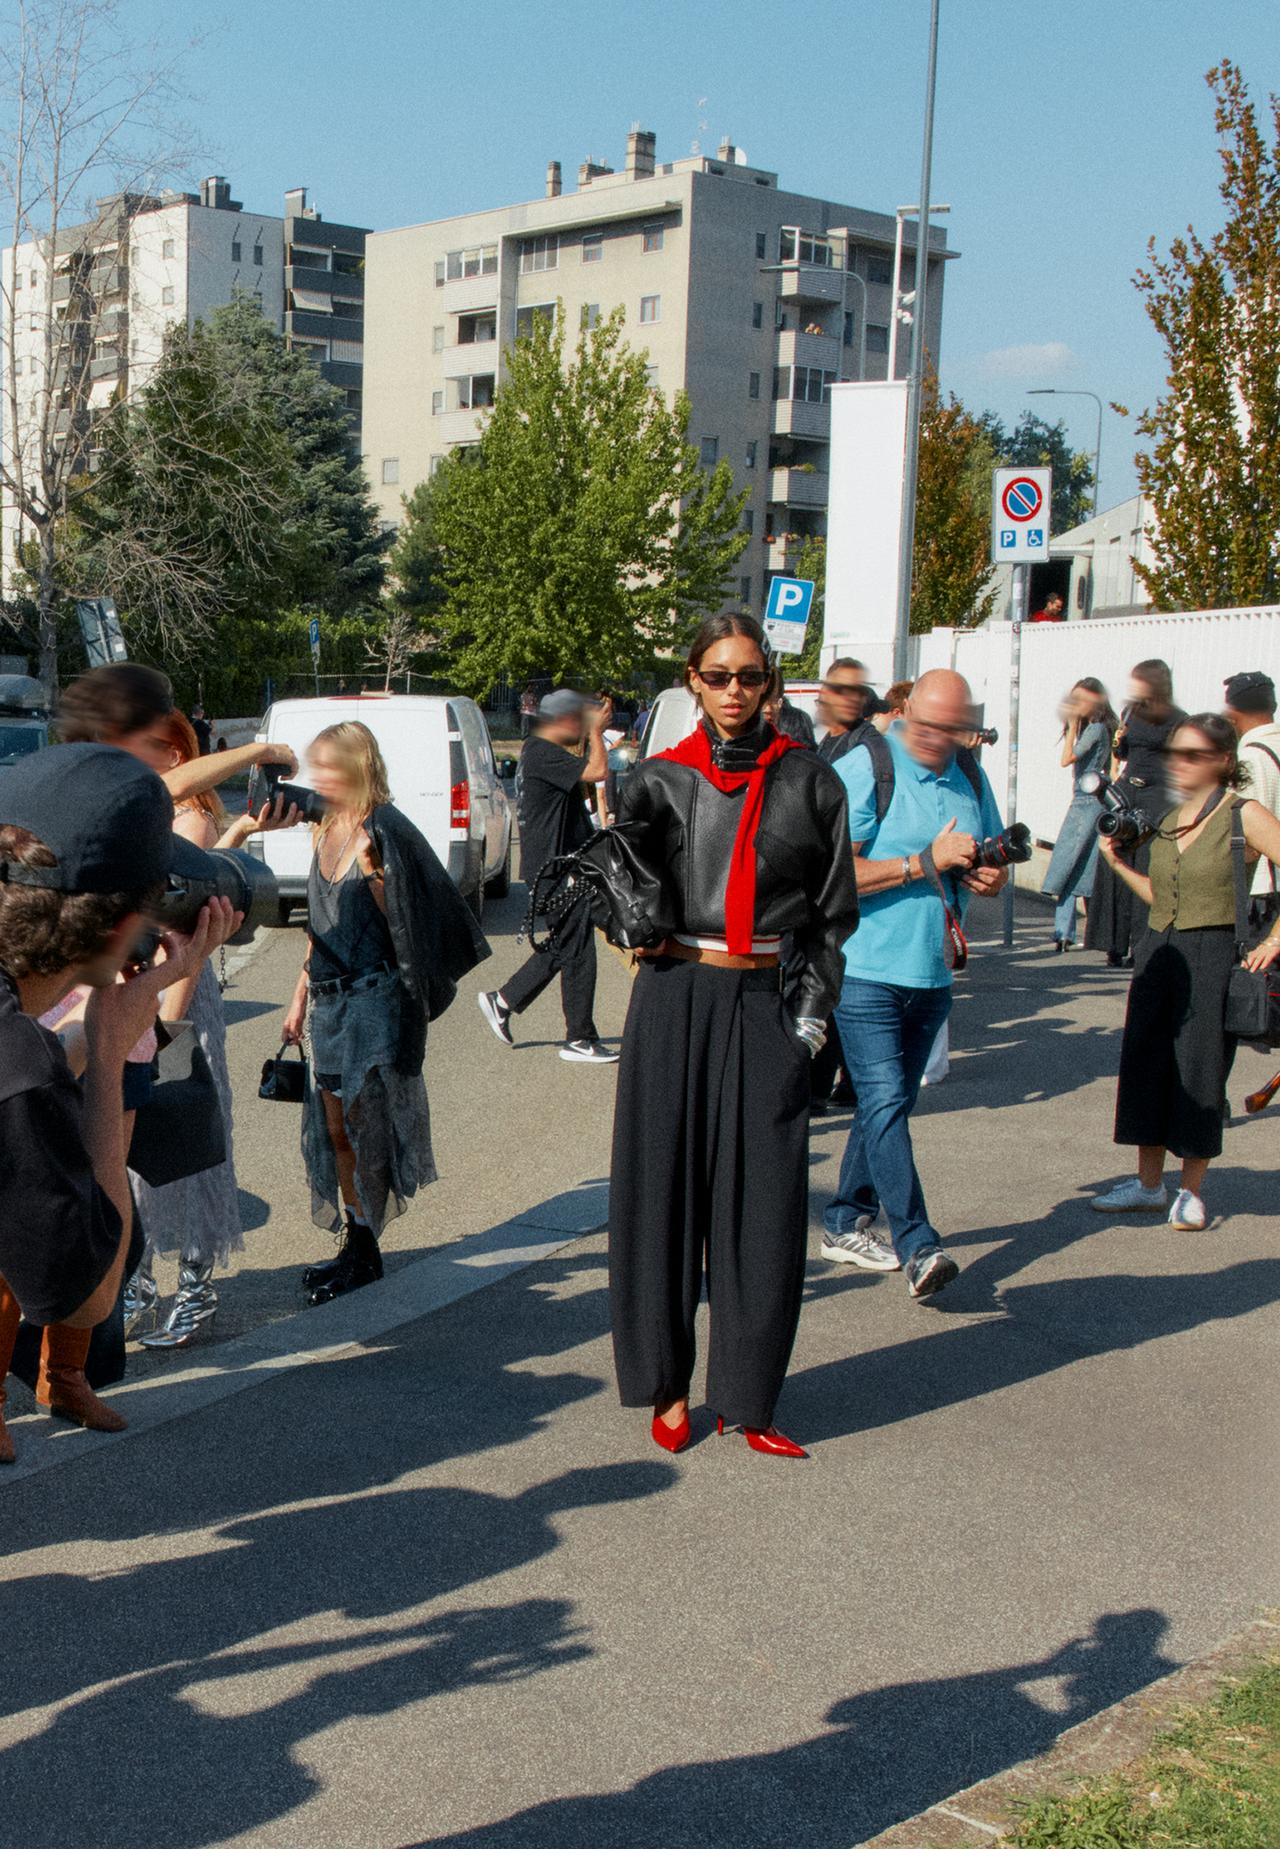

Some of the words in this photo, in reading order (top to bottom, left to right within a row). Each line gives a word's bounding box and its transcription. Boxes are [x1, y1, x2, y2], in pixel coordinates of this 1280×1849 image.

[1003, 532, 1013, 546] P
[775, 583, 803, 615] P
[311, 623, 317, 641] P
